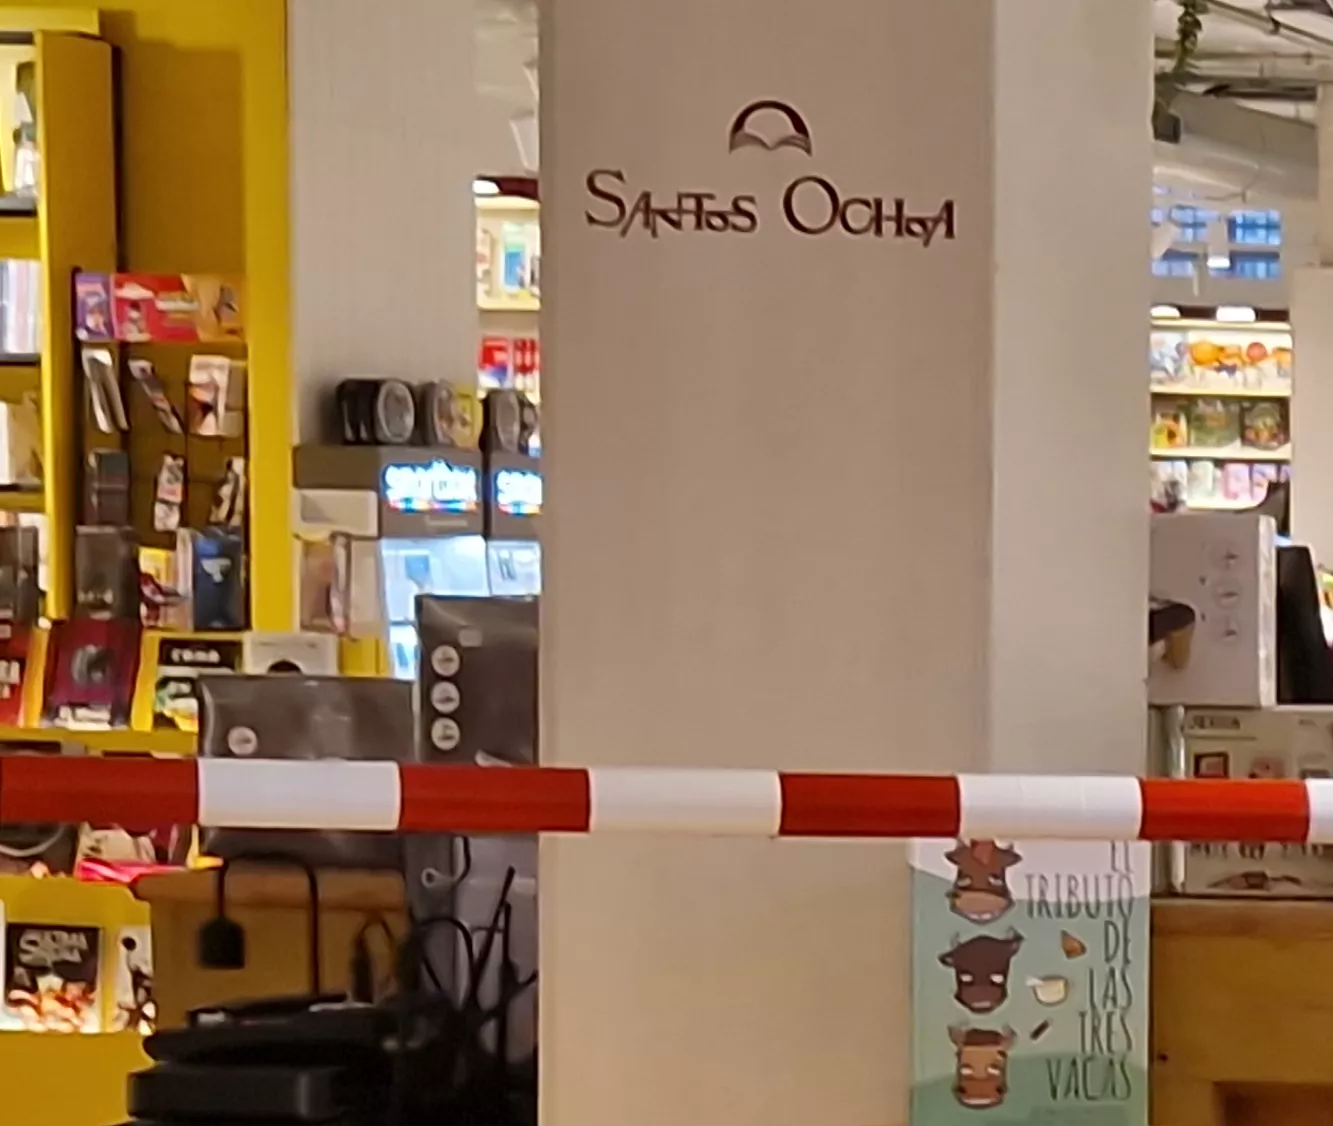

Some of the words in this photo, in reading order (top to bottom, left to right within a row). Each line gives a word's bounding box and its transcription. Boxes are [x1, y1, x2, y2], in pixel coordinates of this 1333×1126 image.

[783, 175, 955, 248] OCHOA
[1024, 873, 1134, 920] TRIBUTO
[1103, 919, 1132, 965] DE
[1089, 966, 1133, 1011] LAS
[1078, 1010, 1133, 1055] TRES
[1046, 1056, 1132, 1102] VACAS
